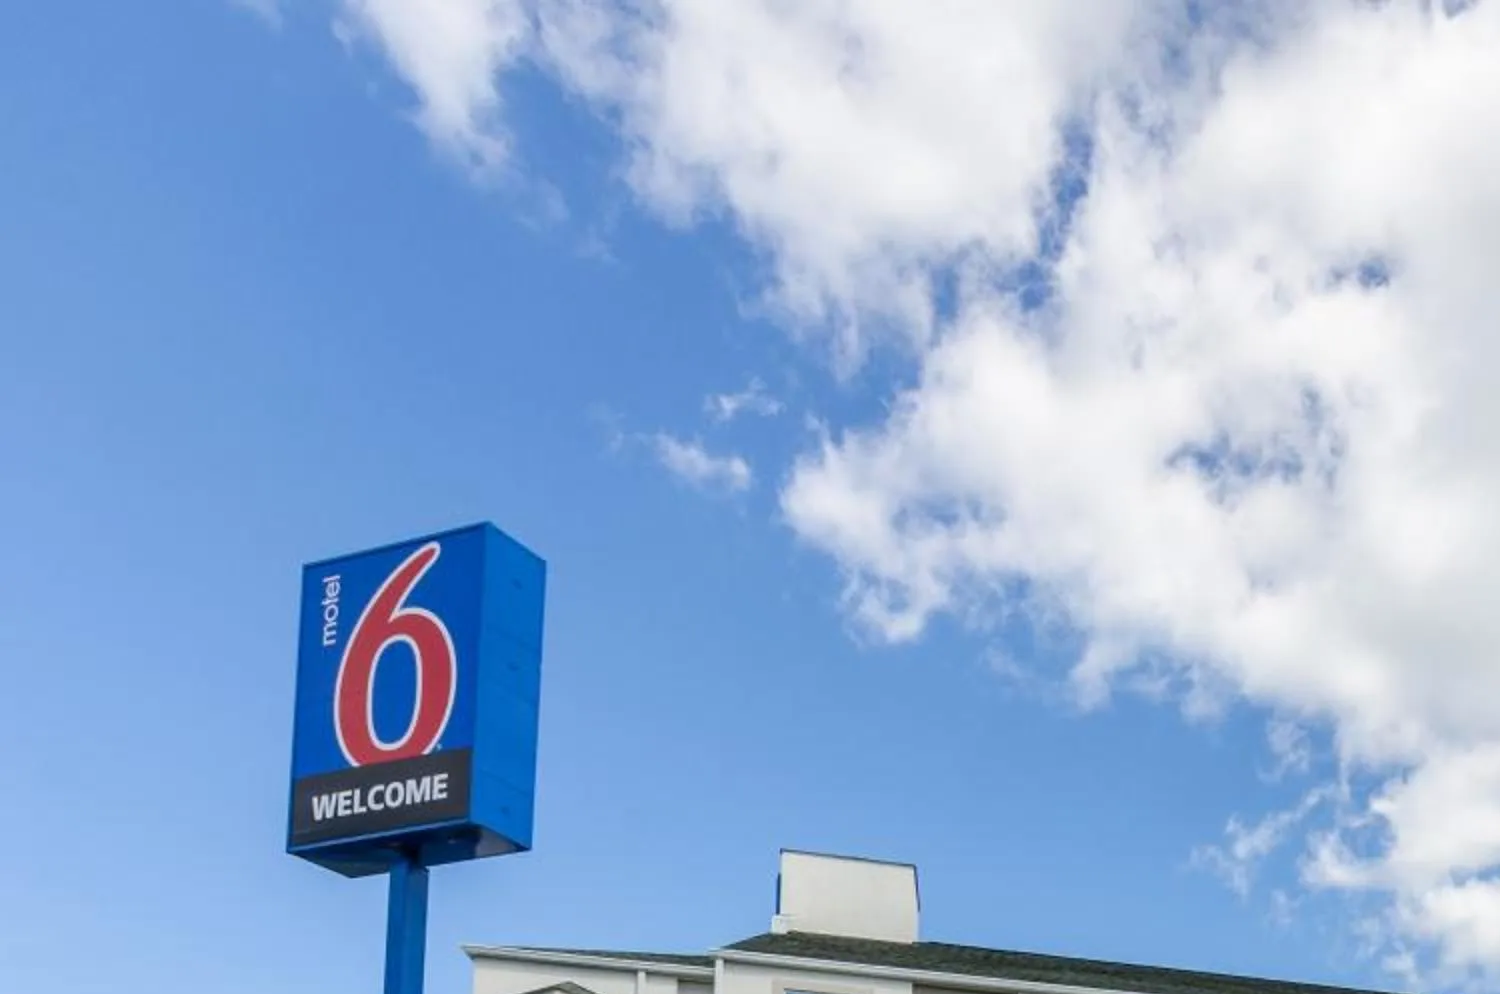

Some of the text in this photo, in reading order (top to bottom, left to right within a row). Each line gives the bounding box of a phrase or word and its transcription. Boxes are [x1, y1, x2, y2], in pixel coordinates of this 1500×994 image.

[321, 541, 457, 767] motel 6
[311, 773, 449, 821] WELCOME
